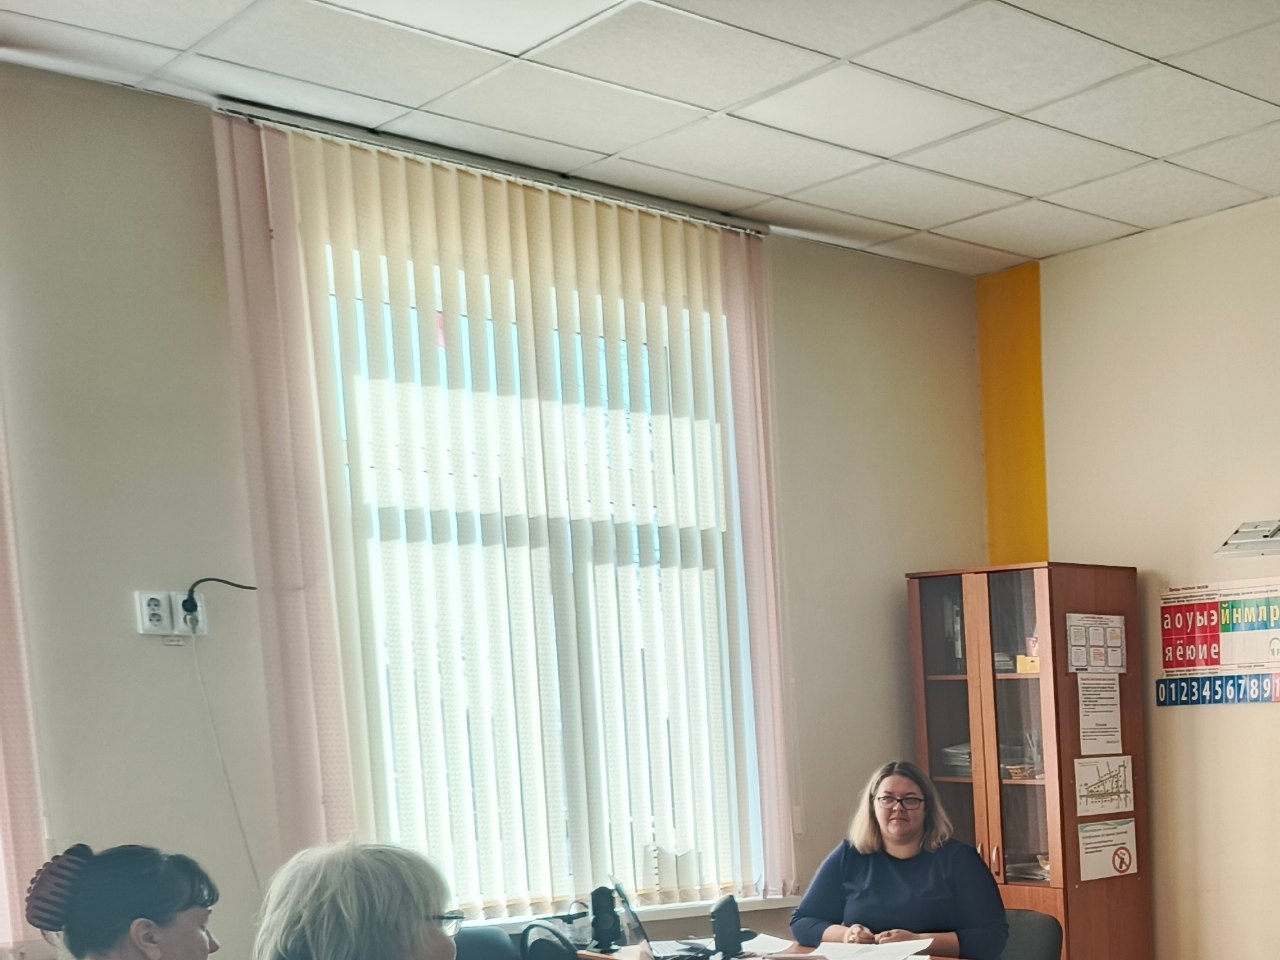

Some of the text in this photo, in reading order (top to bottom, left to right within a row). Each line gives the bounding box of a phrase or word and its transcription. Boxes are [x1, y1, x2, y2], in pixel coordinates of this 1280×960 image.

[1164, 613, 1171, 629] а
[1175, 612, 1183, 628] о
[1186, 611, 1193, 632] у
[1196, 611, 1207, 627] ы
[1210, 610, 1217, 626] э
[1221, 603, 1229, 624] й
[1233, 608, 1241, 623] н
[1244, 607, 1256, 623] м
[1258, 605, 1267, 621] л
[1270, 605, 1279, 627] р
[1165, 646, 1172, 661] я
[1176, 640, 1183, 660] ё
[1186, 644, 1196, 660] ю
[1198, 644, 1207, 659] и
[1210, 643, 1219, 659] е
[1159, 684, 1165, 701] 0
[1169, 683, 1175, 701] 1
[1181, 682, 1187, 700] 2
[1191, 682, 1198, 700] 3
[1203, 681, 1210, 699] 4
[1215, 680, 1222, 699] 5
[1226, 679, 1234, 699] 6
[1238, 679, 1246, 699] 7
[1250, 679, 1258, 699] 8
[1263, 678, 1271, 698] 9
